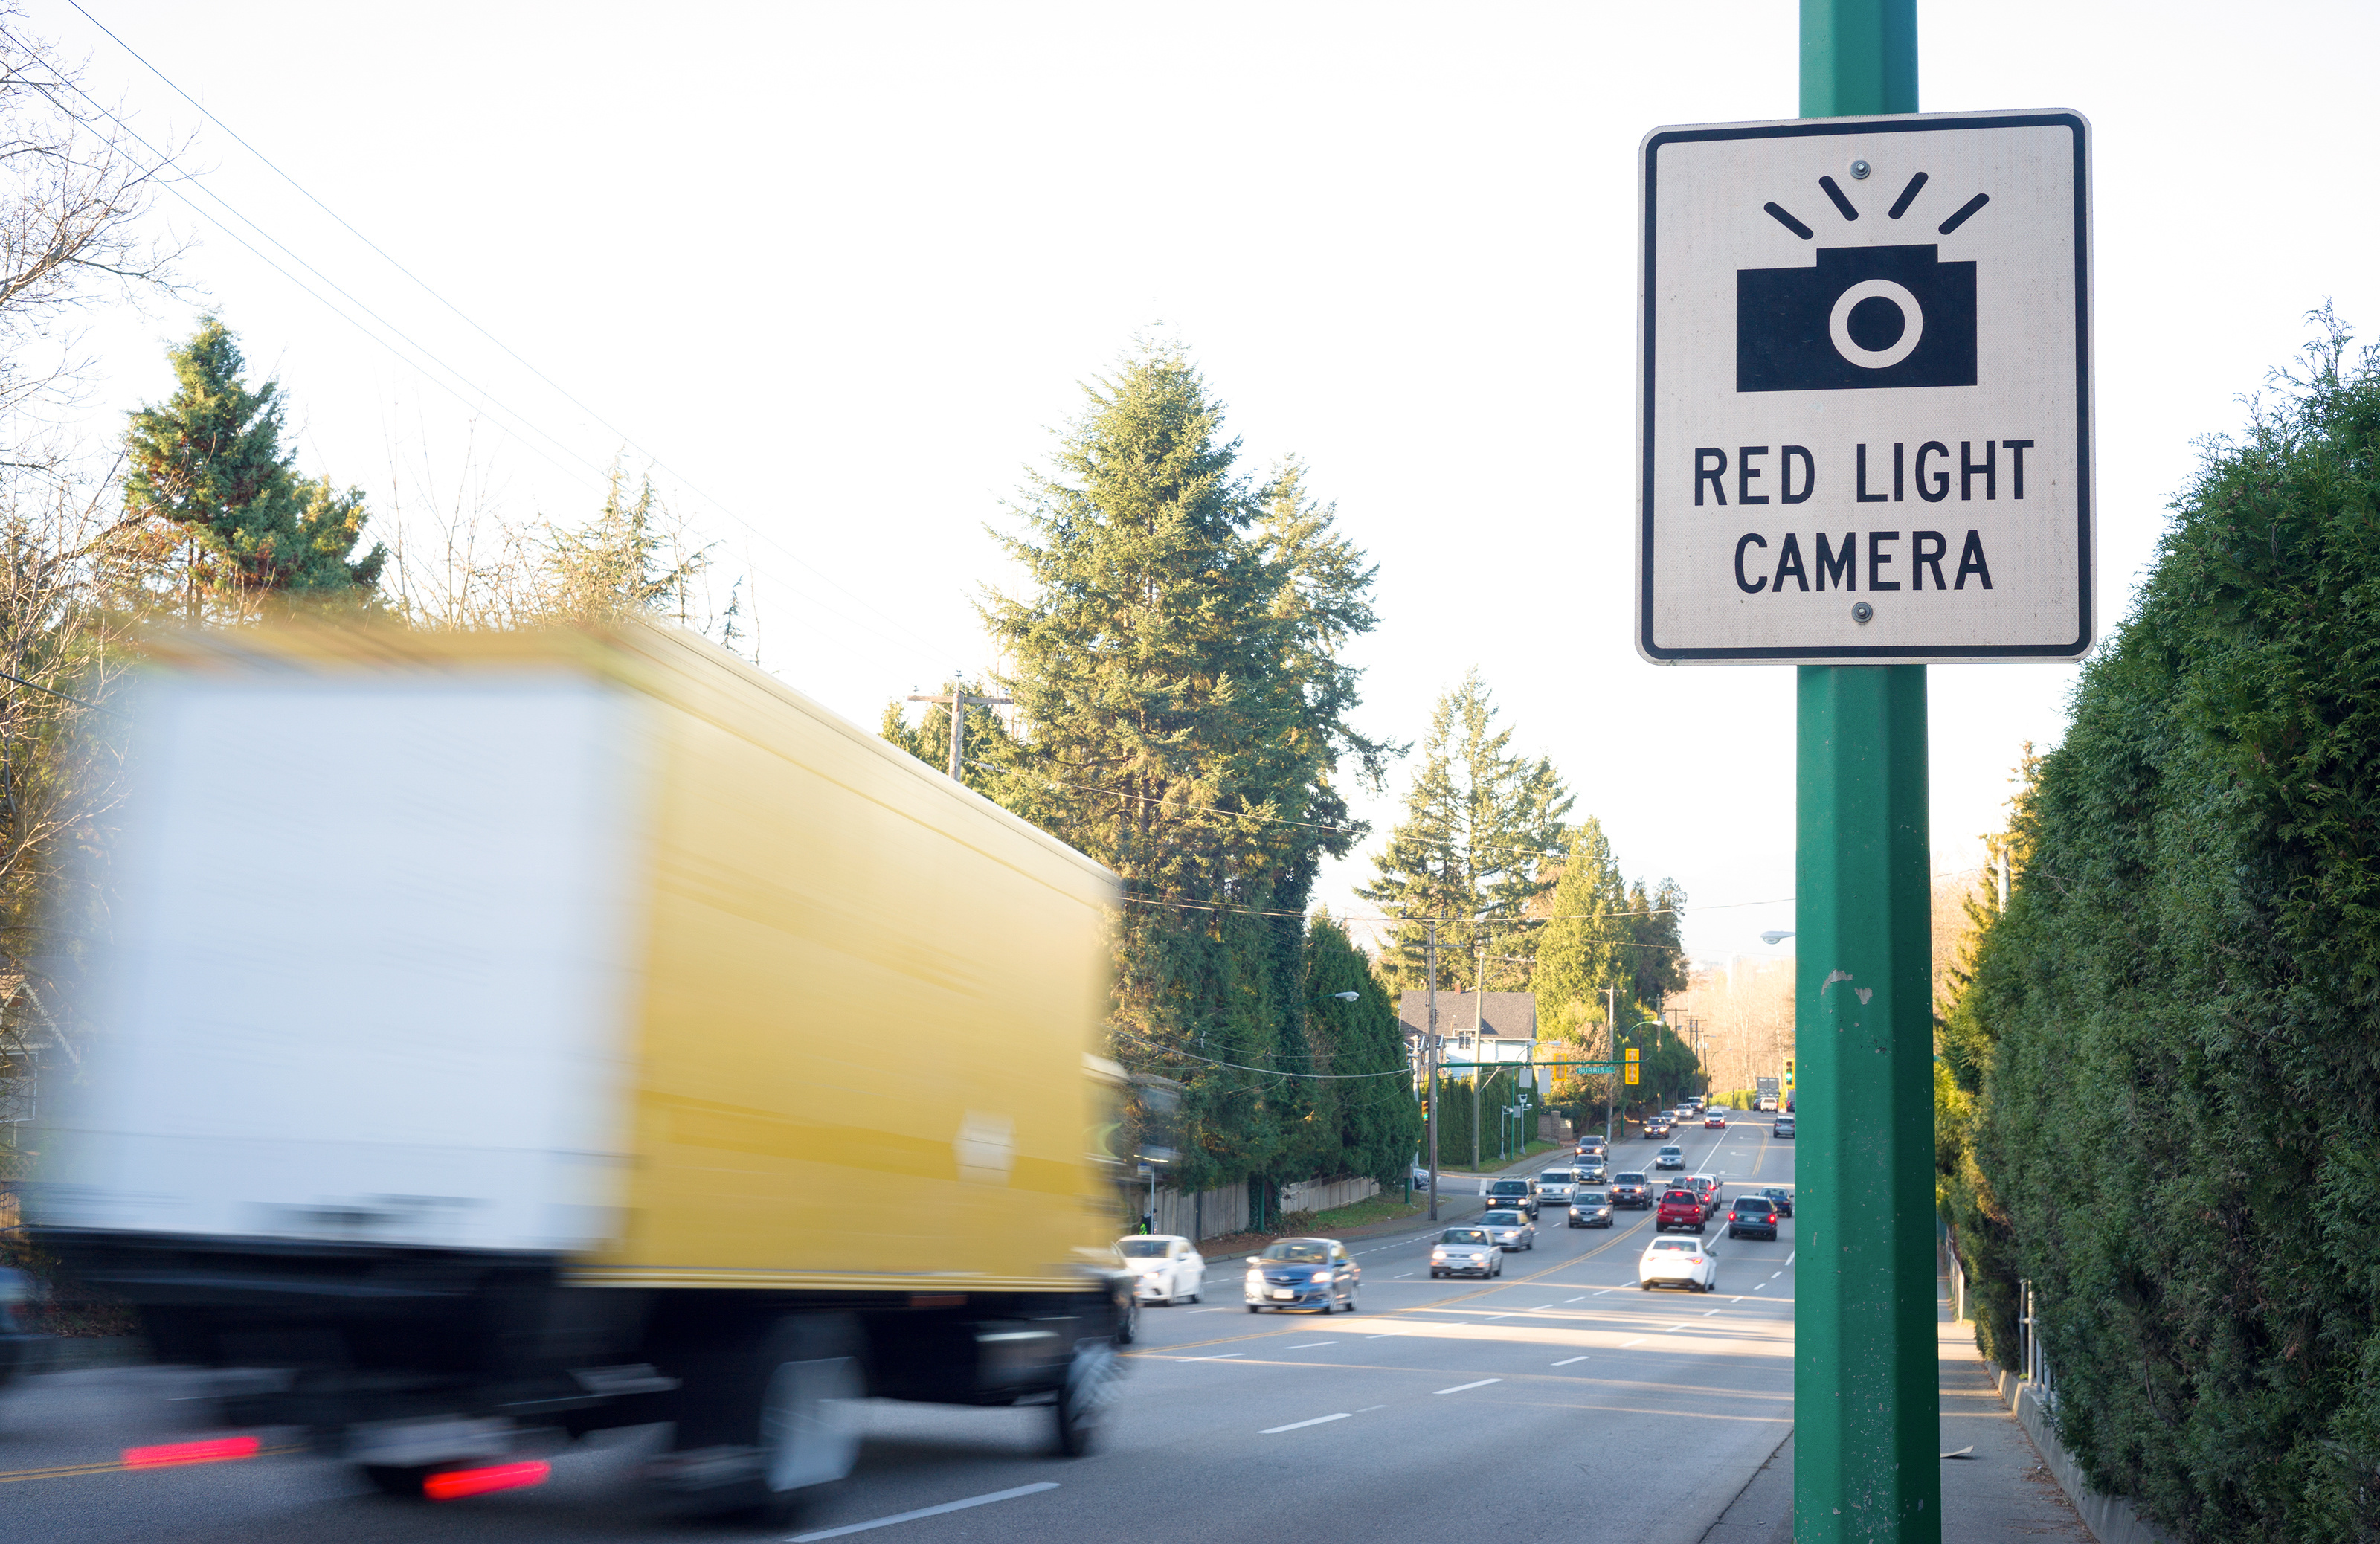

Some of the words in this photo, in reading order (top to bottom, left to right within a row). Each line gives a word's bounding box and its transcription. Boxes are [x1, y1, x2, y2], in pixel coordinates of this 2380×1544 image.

[1694, 445, 1815, 506] RED
[1856, 440, 2035, 503] LIGHT
[1734, 530, 1993, 594] CAMERA
